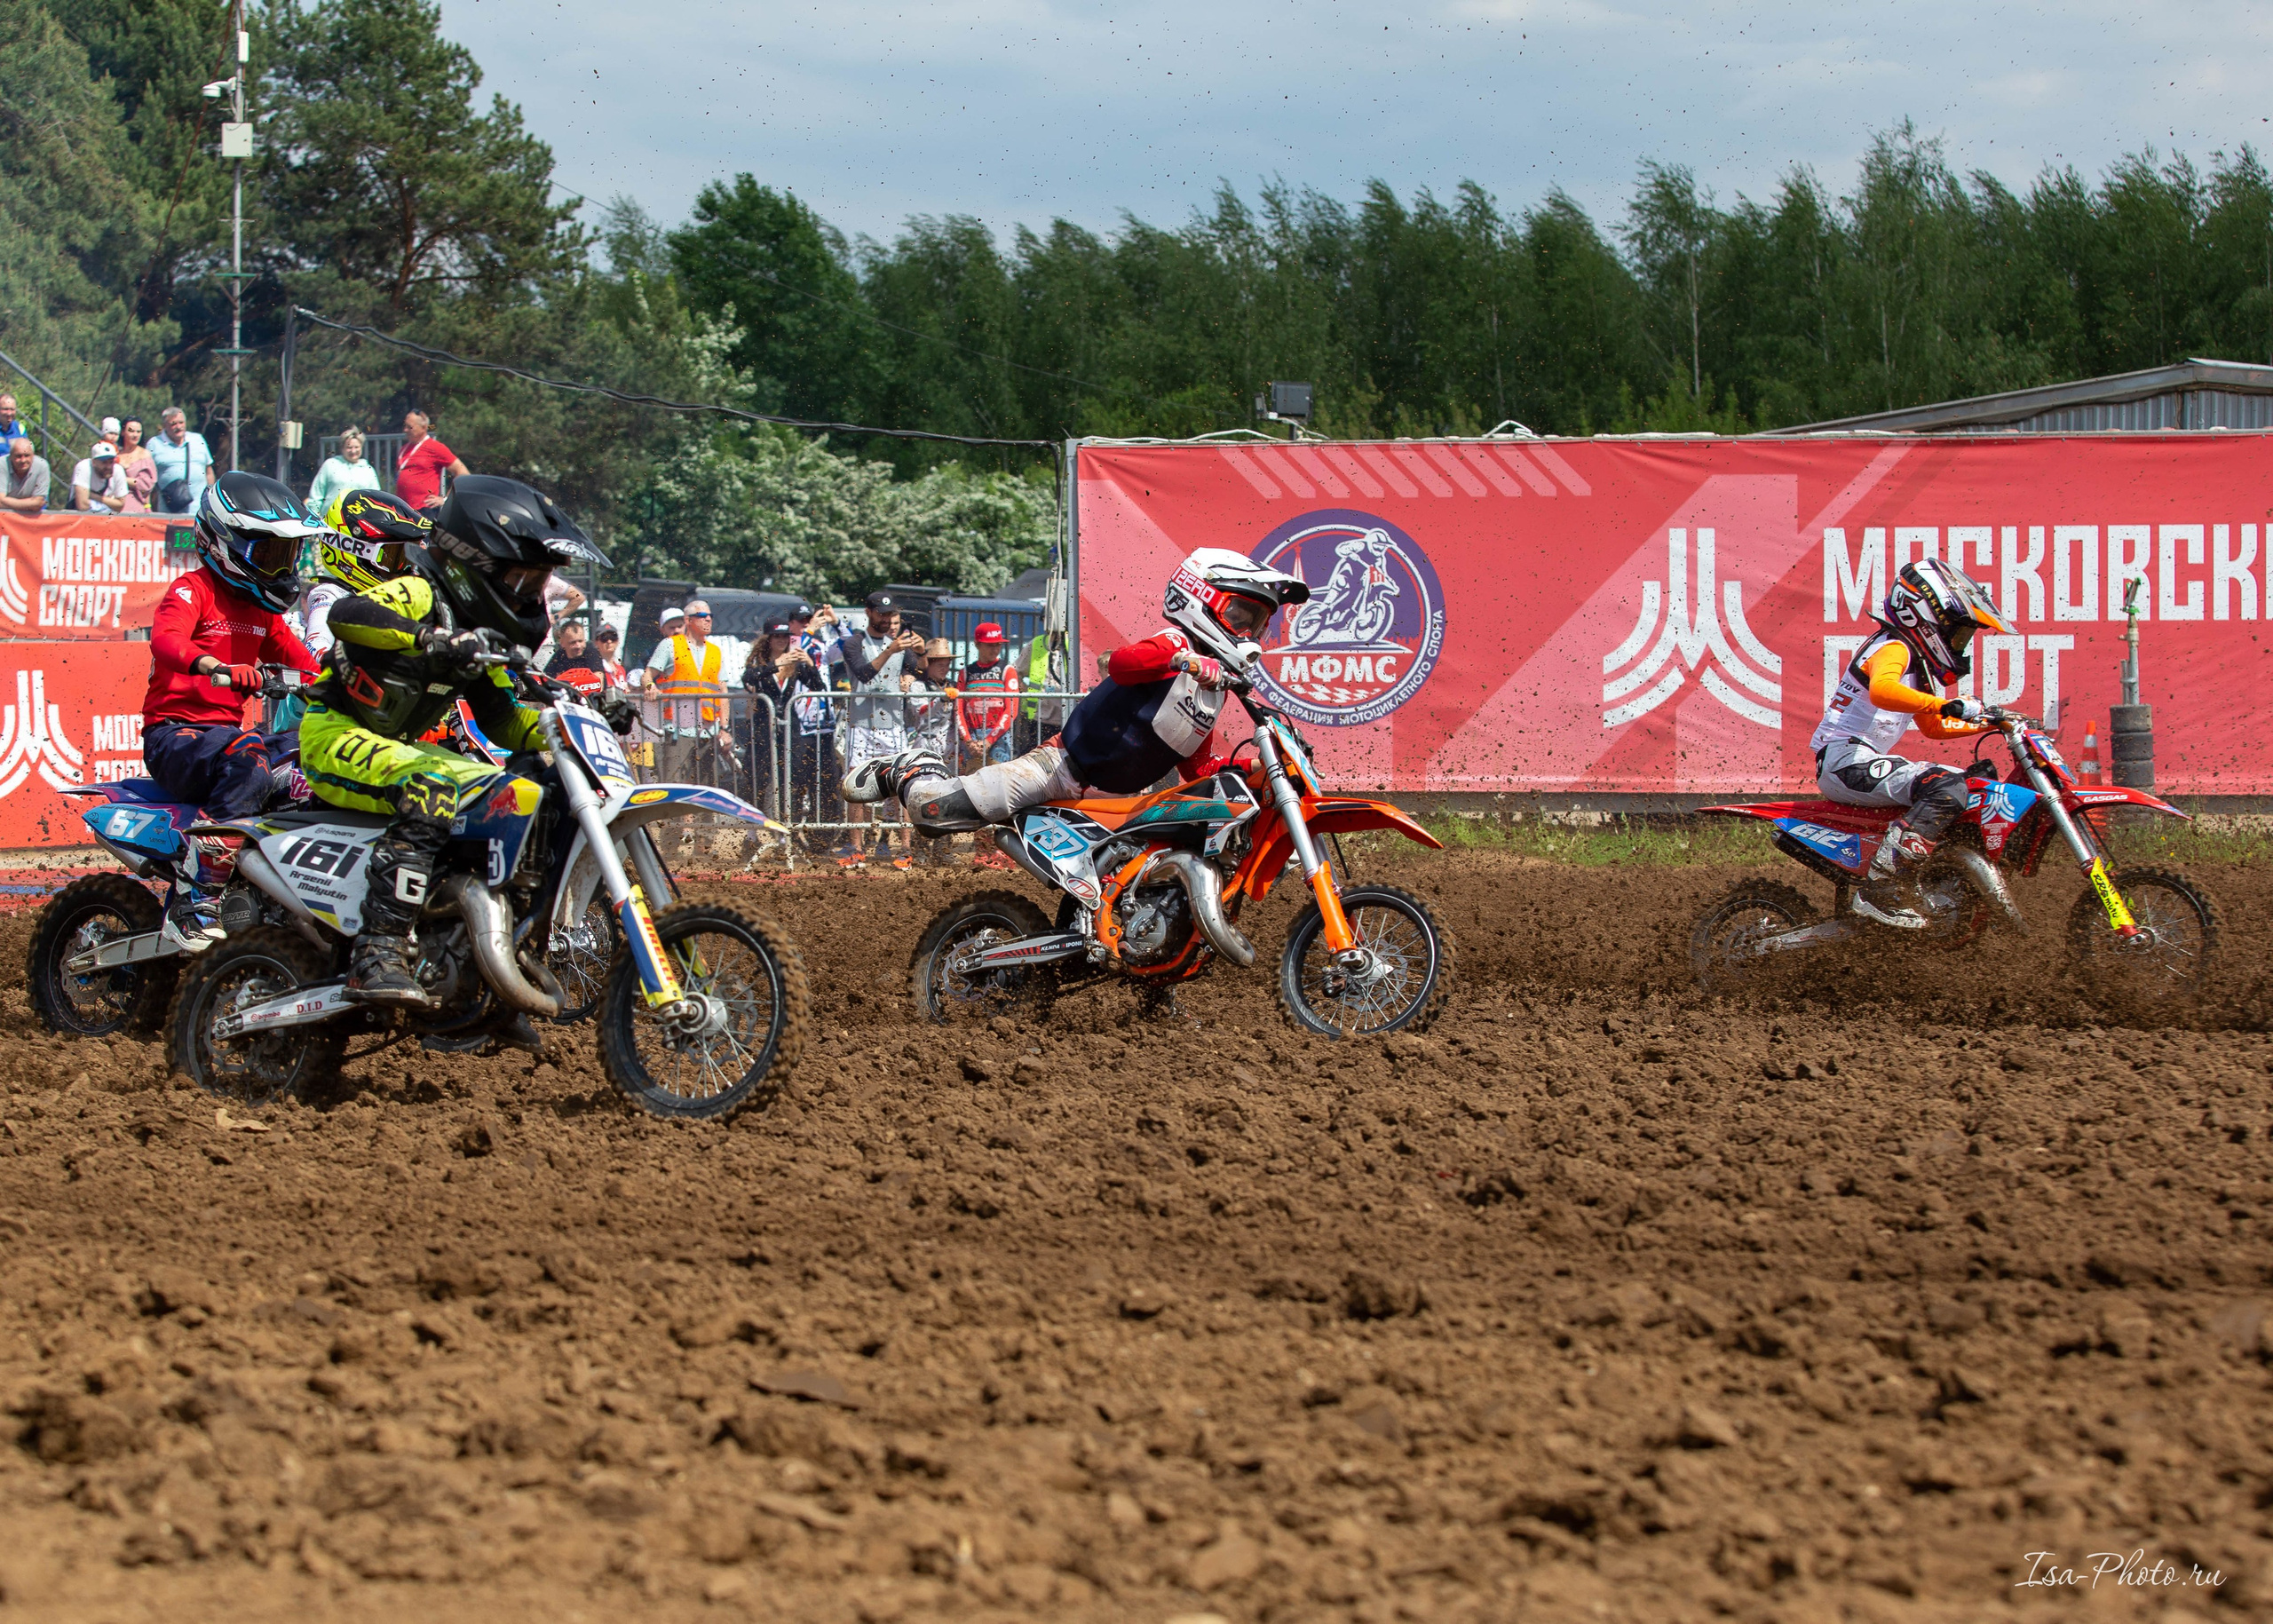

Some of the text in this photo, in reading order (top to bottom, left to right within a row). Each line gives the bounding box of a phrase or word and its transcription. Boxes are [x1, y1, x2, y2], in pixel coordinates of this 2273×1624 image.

[1824, 524, 2273, 622] МСКОВСК
[38, 584, 127, 628] СПОРТ
[1247, 609, 1444, 725] КАЯ ФЕДЕРАЦИЯ МОТОЦИКЛЕТНОГО СПОРТА
[1279, 654, 1397, 684] МФМС
[1823, 634, 2075, 731] СРТ
[1839, 679, 1861, 693] TOV
[92, 715, 145, 751] МОС
[2083, 794, 2128, 803] GASGAS
[105, 809, 157, 839] 67
[280, 836, 366, 879] 161
[289, 870, 333, 887] Arsenii
[297, 882, 348, 901] Malyutin
[297, 1000, 323, 1014] D.I.D
